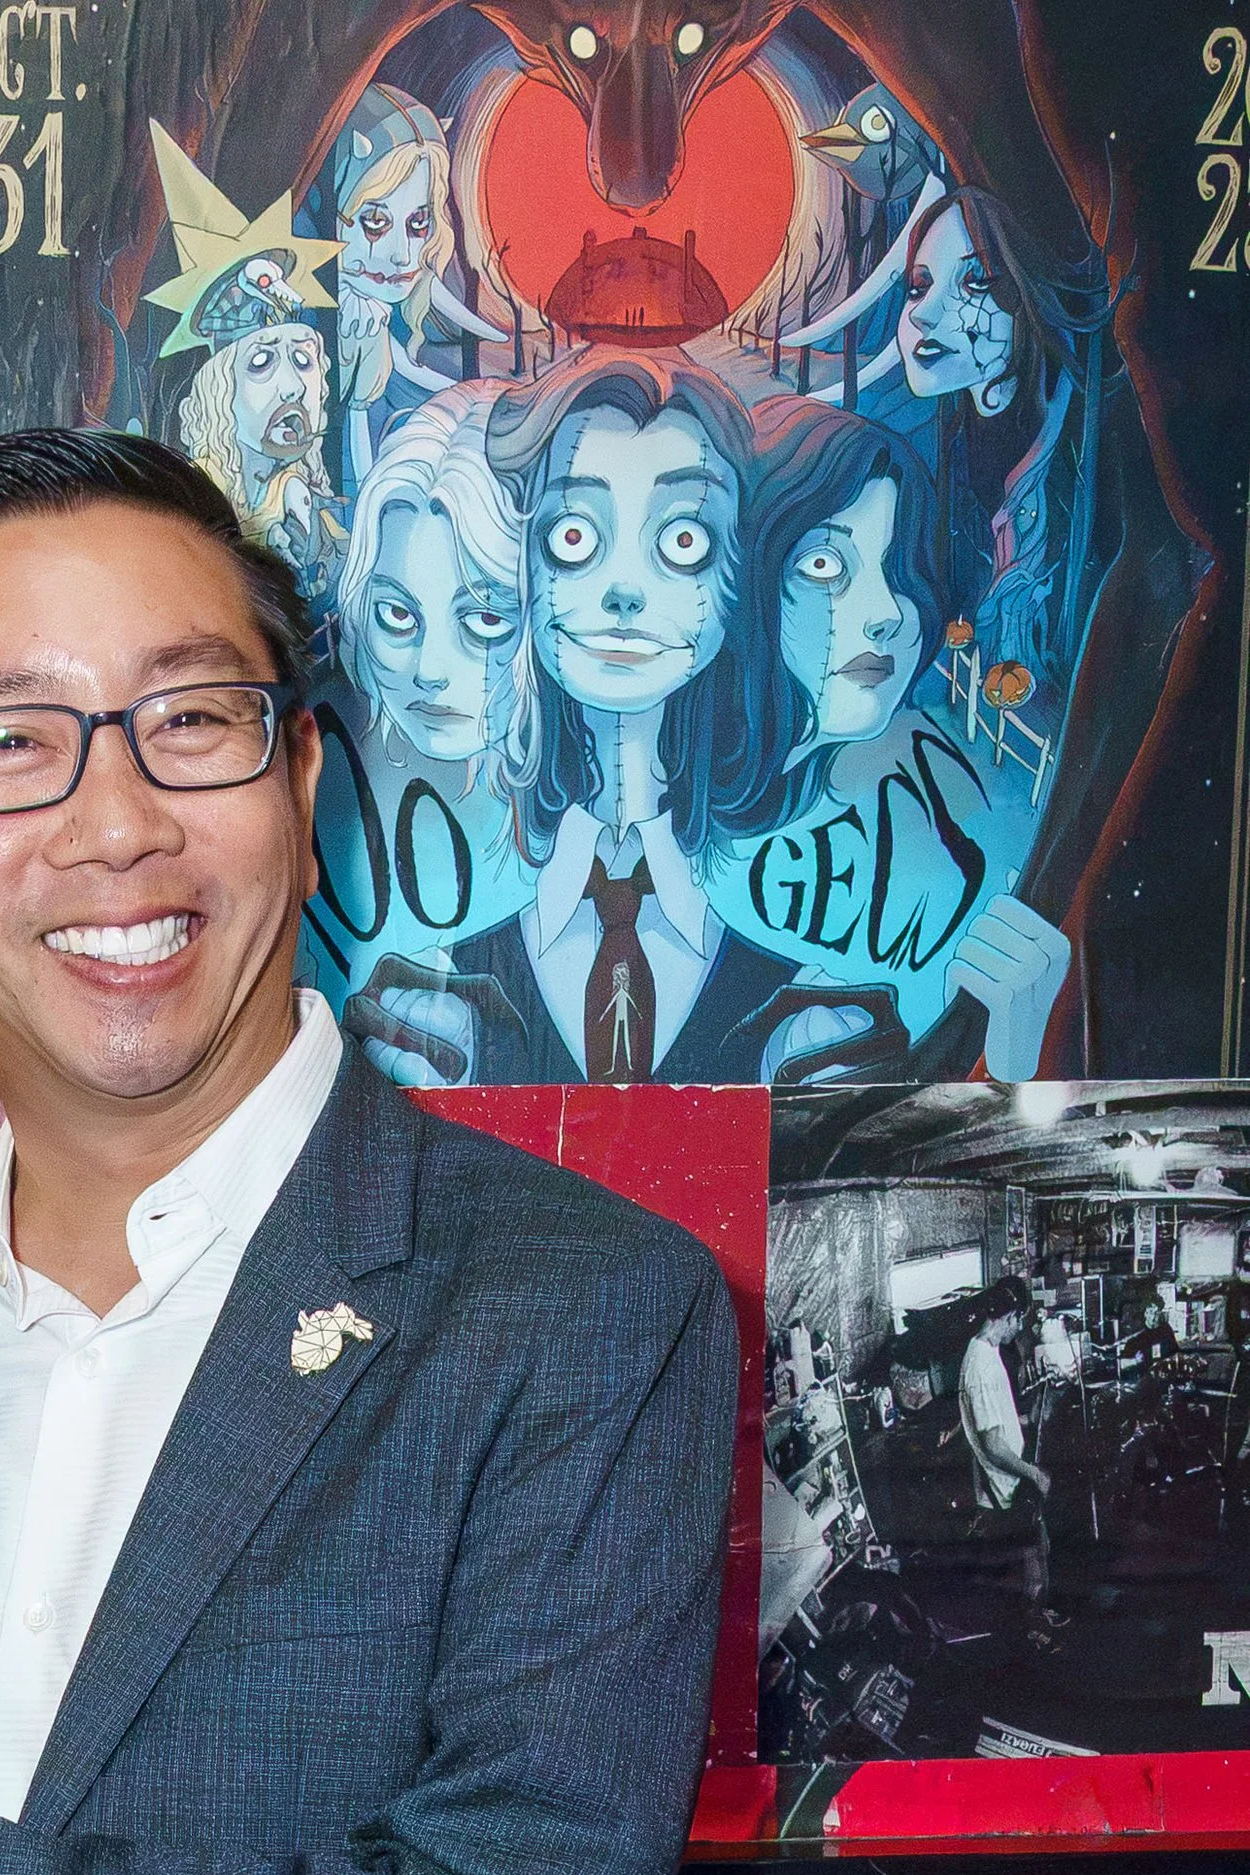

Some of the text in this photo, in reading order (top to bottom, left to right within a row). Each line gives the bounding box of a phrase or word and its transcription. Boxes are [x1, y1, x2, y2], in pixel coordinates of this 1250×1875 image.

[1195, 27, 1250, 145] 2
[1189, 153, 1250, 272] 2
[749, 711, 993, 973] GECS
